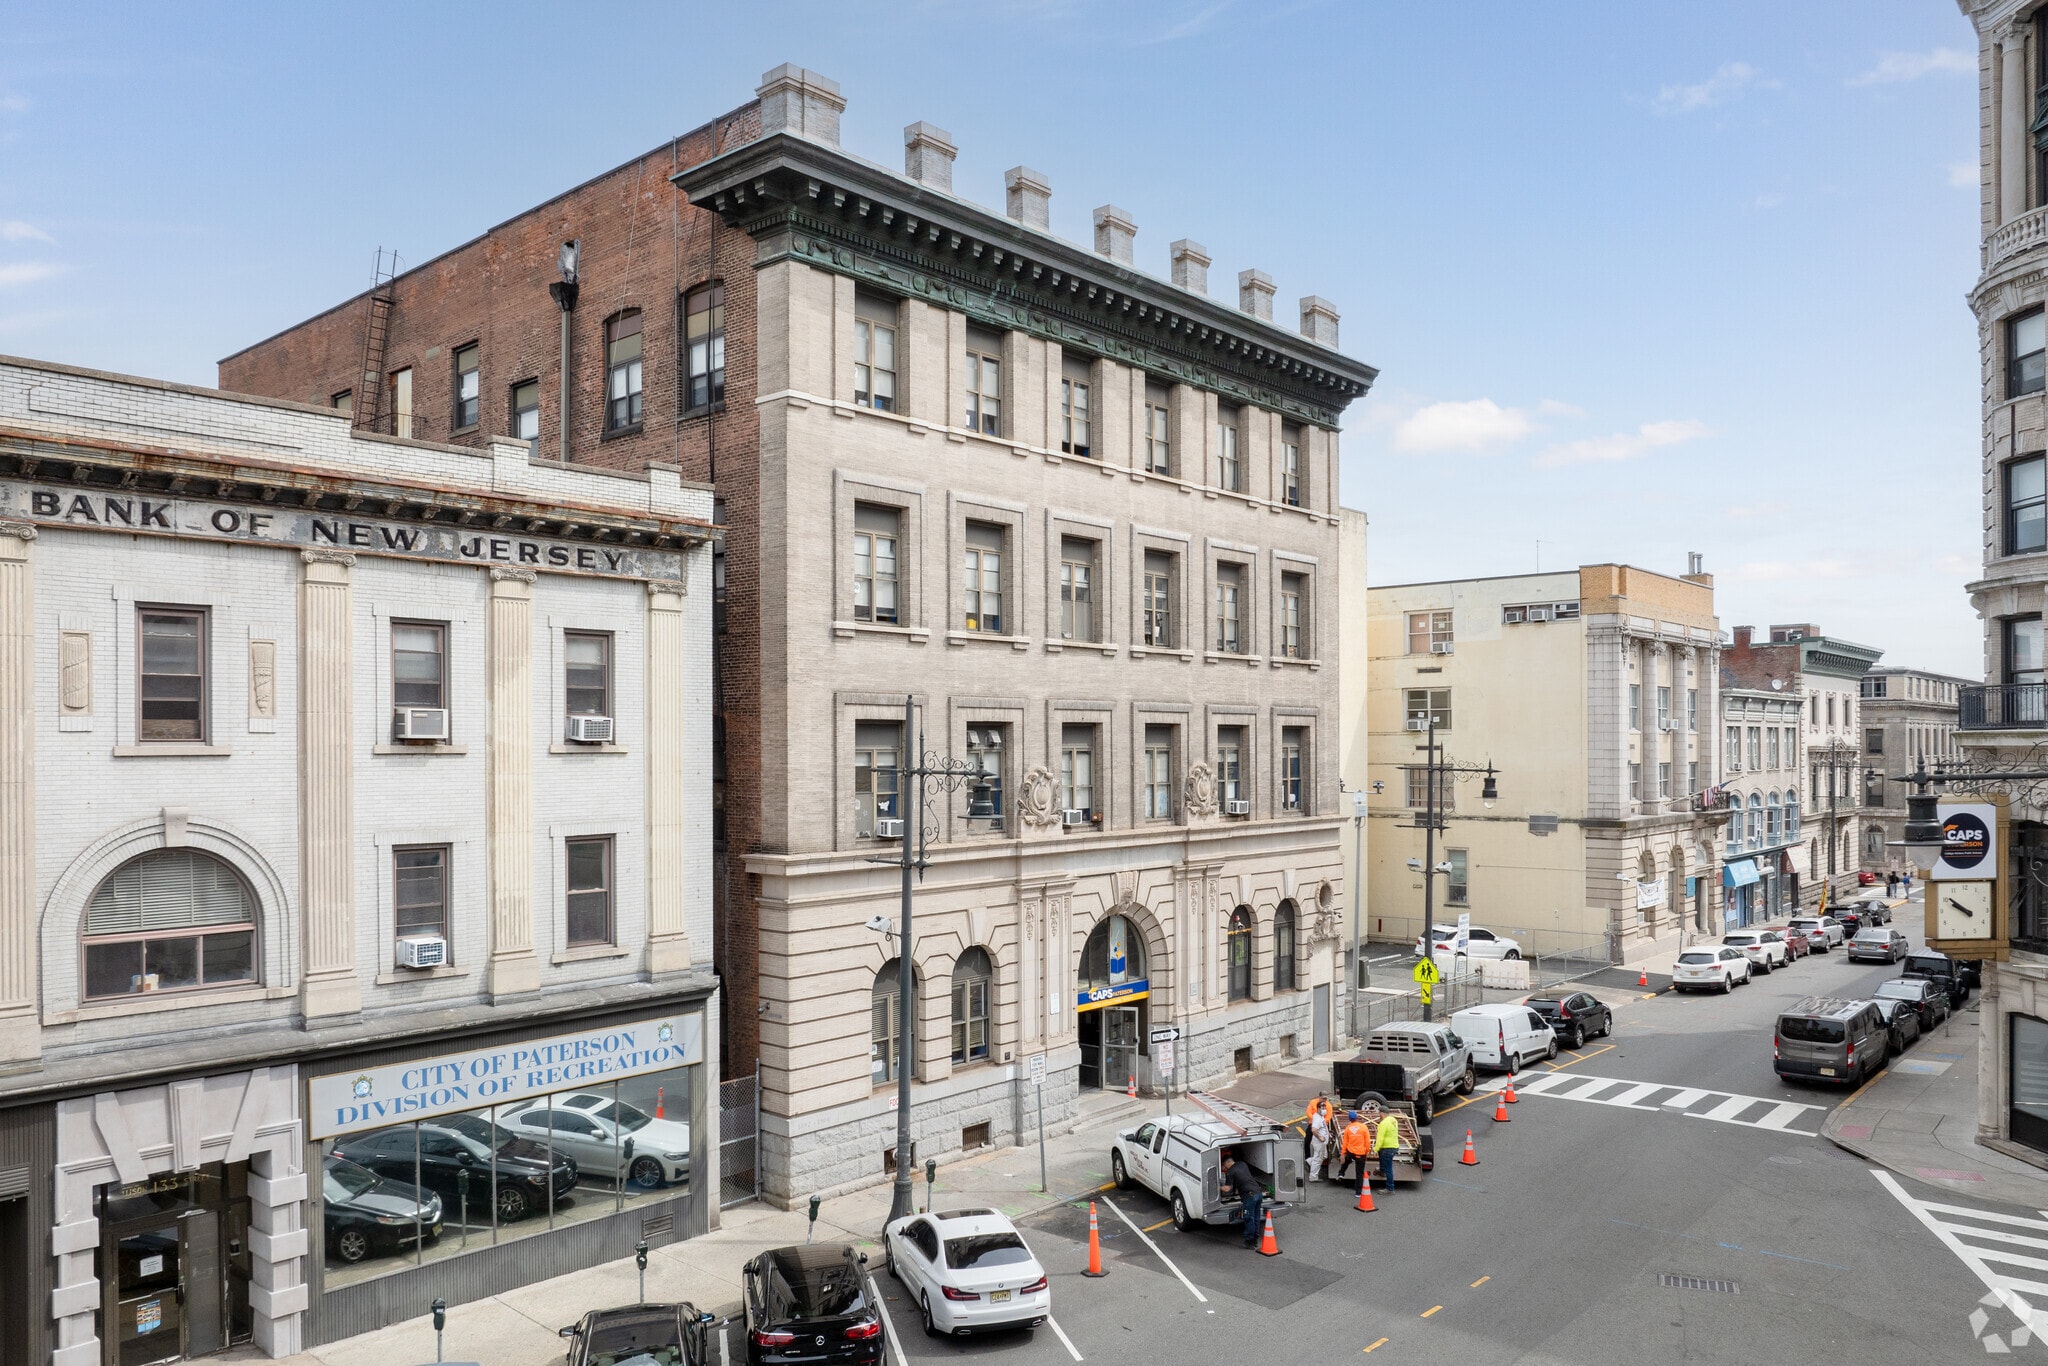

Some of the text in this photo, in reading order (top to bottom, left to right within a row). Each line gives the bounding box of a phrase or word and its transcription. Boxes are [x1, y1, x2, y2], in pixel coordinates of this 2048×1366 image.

[31, 490, 622, 571] BANK OF NEW JERSEY
[1947, 829, 1983, 841] CAPS
[1091, 988, 1113, 1001] CAPS
[401, 1031, 637, 1092] CITY OF PATERSON
[335, 1042, 687, 1126] DIVISION OF RECREATION
[152, 1177, 179, 1194] 133
